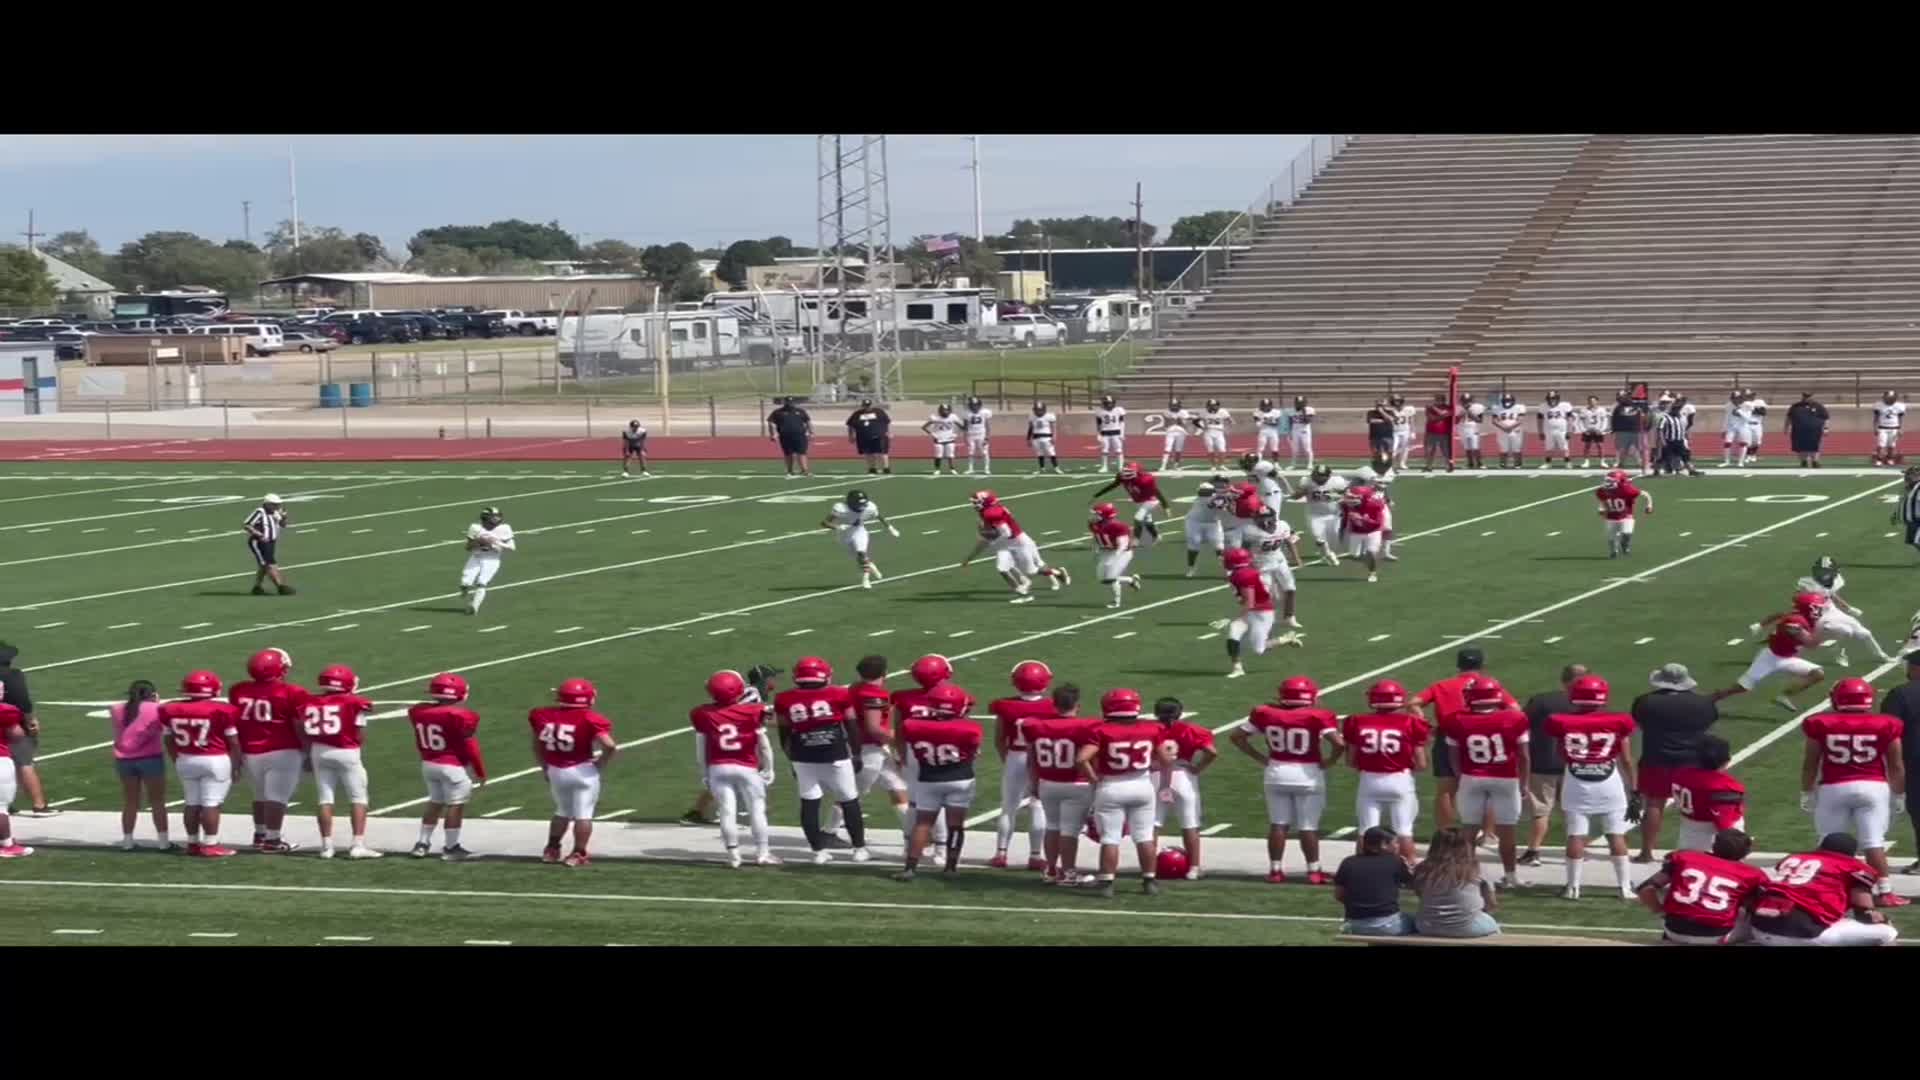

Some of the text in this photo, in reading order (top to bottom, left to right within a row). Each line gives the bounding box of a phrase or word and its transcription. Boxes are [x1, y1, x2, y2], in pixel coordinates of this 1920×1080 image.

[1607, 498, 1626, 512] 10
[238, 699, 271, 722] 70
[303, 705, 341, 735] 25
[171, 718, 210, 747] 57
[416, 722, 446, 751] 16
[539, 723, 576, 752] 45
[718, 724, 742, 750] 2
[1265, 726, 1310, 755] 80
[1360, 728, 1400, 754] 36
[1564, 732, 1616, 759] 87
[1035, 738, 1075, 769] 60
[1107, 740, 1152, 770] 53
[1467, 734, 1507, 764] 81
[1826, 734, 1878, 764] 55
[1779, 857, 1822, 885] 69
[1673, 868, 1738, 911] 35
